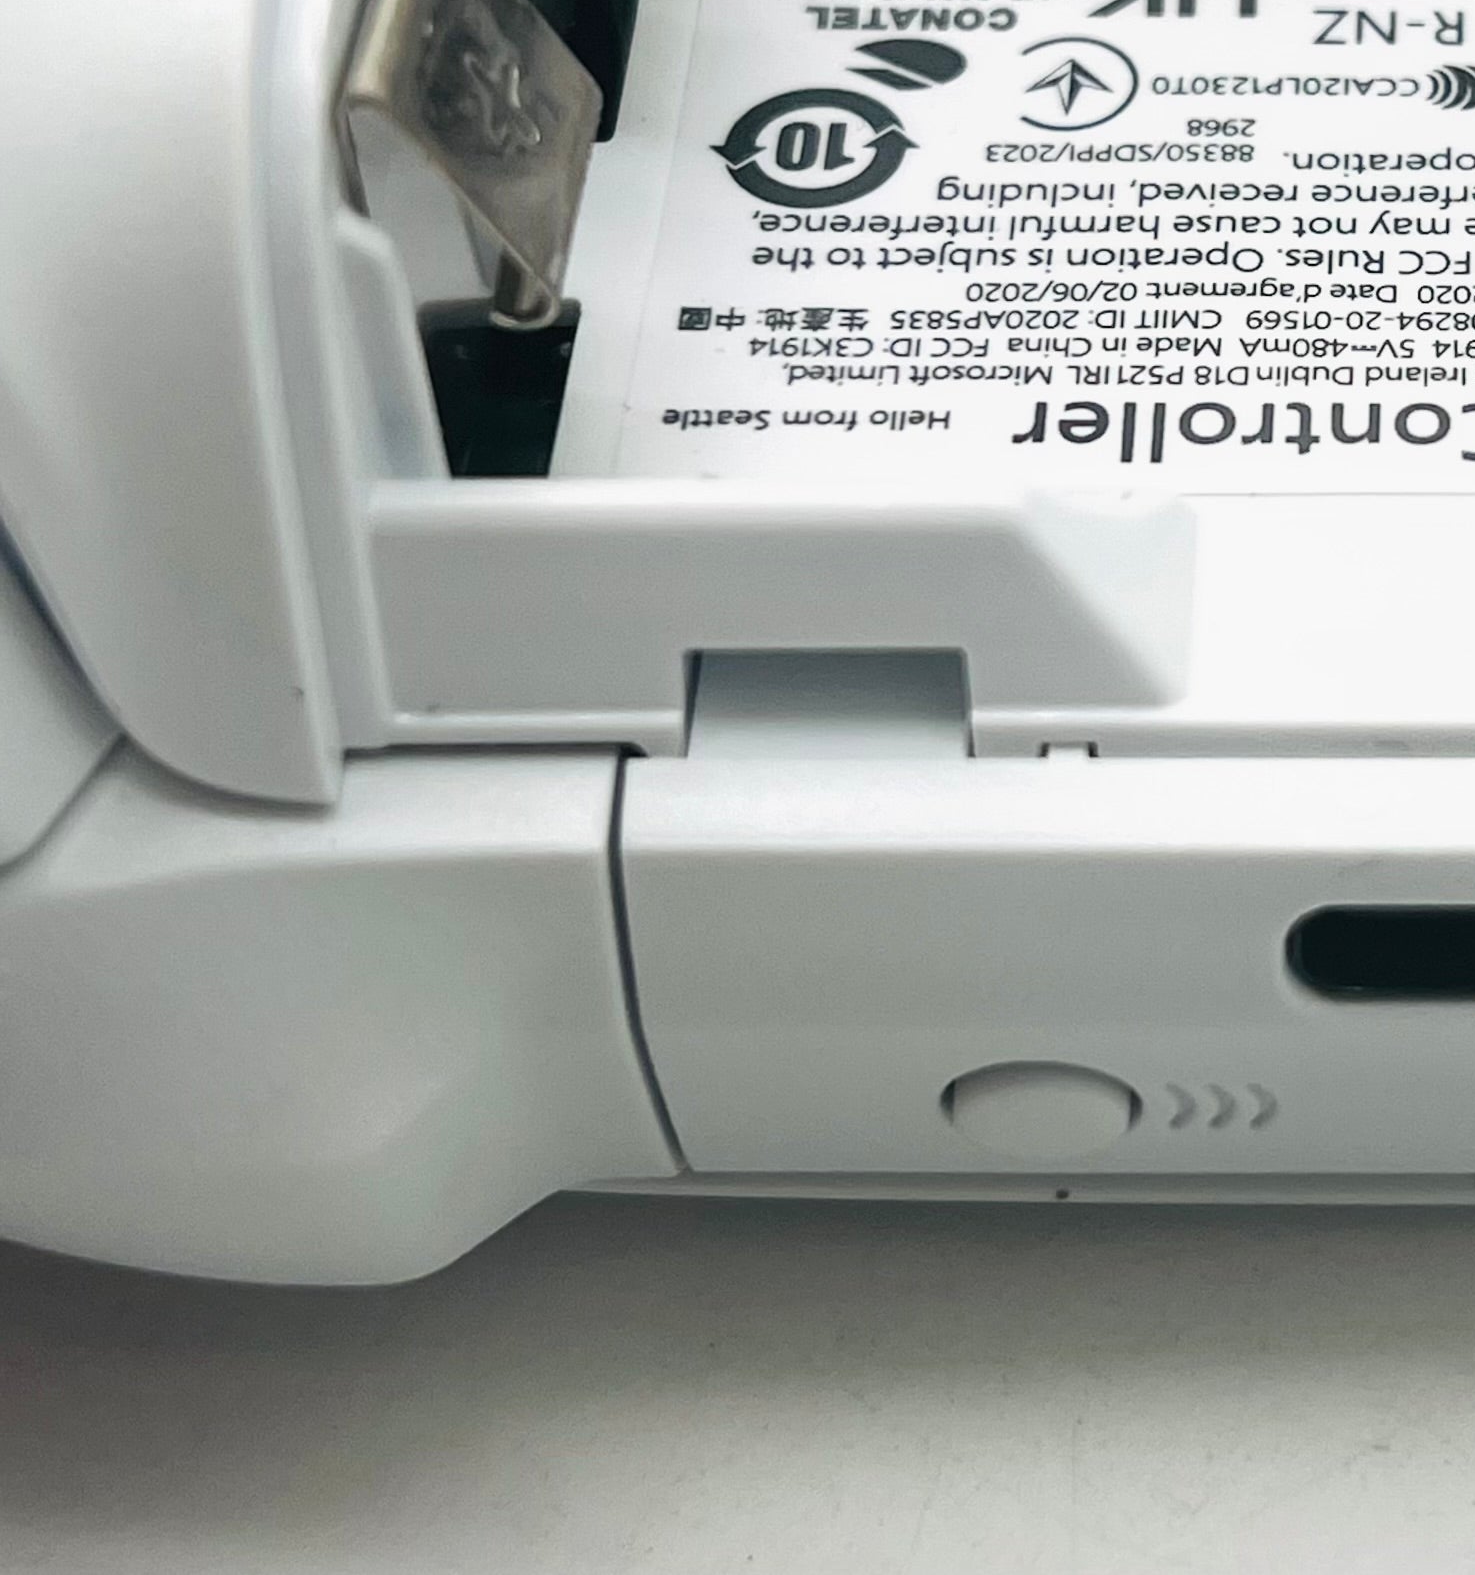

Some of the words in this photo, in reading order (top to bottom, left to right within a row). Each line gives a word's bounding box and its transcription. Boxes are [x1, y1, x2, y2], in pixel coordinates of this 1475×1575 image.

[804, 5, 1019, 33] CONATEL
[1312, 8, 1465, 47] R-NZ
[1186, 117, 1257, 138] 2968
[774, 120, 856, 172] 10
[985, 141, 1256, 163] 88350/SDPPI/2023
[936, 175, 1116, 209] including
[1129, 179, 1299, 209] received,
[751, 210, 996, 242] interference,
[1008, 214, 1161, 242] harmful
[1172, 214, 1282, 234] cause
[1292, 216, 1358, 239] not
[1368, 209, 1451, 236] may
[751, 246, 816, 273] the
[826, 246, 867, 271] to
[875, 240, 1017, 274] subject
[1027, 247, 1054, 274] is
[1066, 240, 1265, 274] Operation
[1276, 248, 1385, 276] Rules.
[1397, 249, 1472, 276] FCC
[965, 279, 1138, 303] 02/06/2020
[1329, 283, 1398, 304] Date
[890, 309, 1080, 331] 2020AP5835
[1087, 309, 1126, 330] ID:
[1133, 308, 1223, 330] CMIIT
[748, 336, 875, 358] C3K1914
[882, 337, 922, 358] ID:
[929, 337, 990, 359] FCC
[1007, 336, 1093, 359] China
[1101, 336, 1127, 358] in
[1135, 336, 1223, 358] Made
[781, 362, 901, 387] Limited,
[908, 364, 1054, 387] Microsoft
[1193, 364, 1250, 387] D18
[1256, 365, 1355, 387] Dublin
[1364, 365, 1467, 388] Ireland
[661, 408, 772, 432] Seattle
[781, 409, 859, 432] from
[868, 409, 952, 432] Hello
